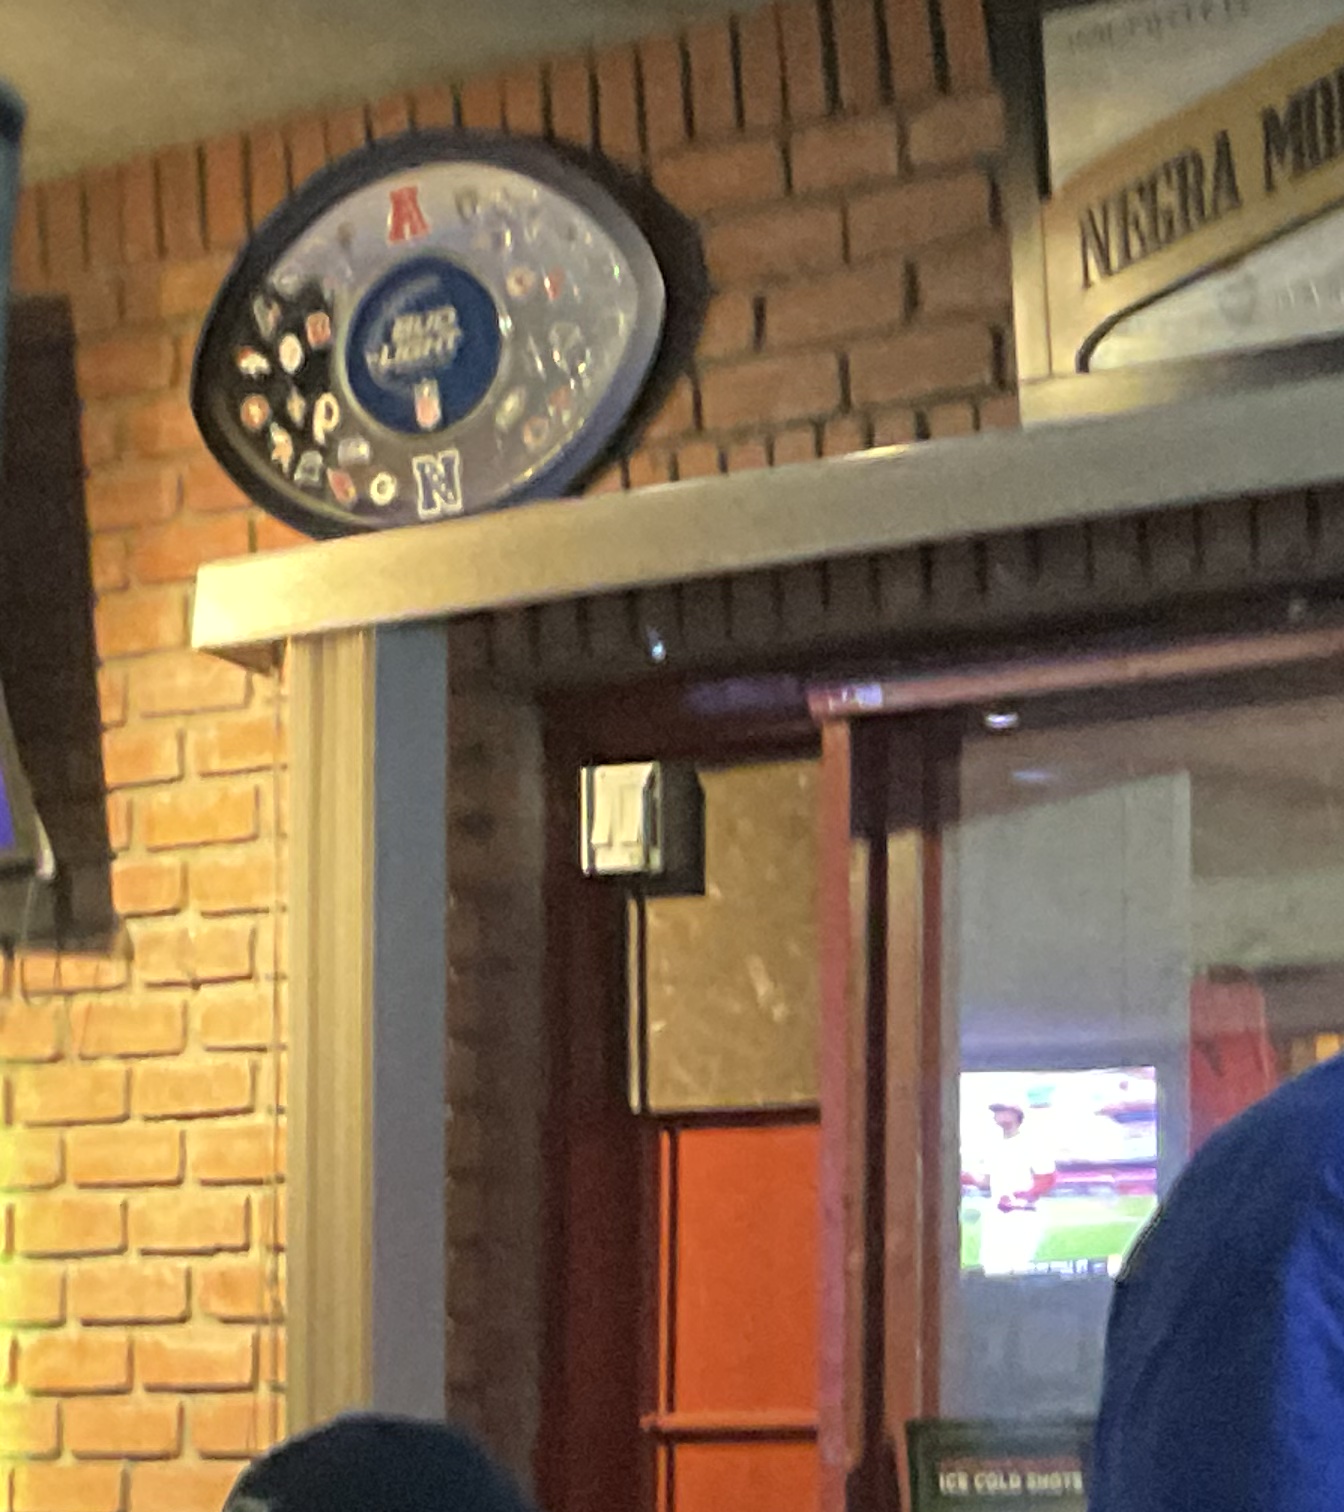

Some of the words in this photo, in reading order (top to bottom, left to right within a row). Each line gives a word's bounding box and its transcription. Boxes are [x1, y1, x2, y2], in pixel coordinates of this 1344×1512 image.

[1078, 129, 1241, 289] NEGRA
[392, 306, 459, 341] BUD
[380, 330, 461, 368] LIGHT
[412, 450, 463, 521] N
[939, 1471, 968, 1494] ICE
[974, 1471, 1023, 1494] COLD
[1026, 1471, 1083, 1492] SHOTS
